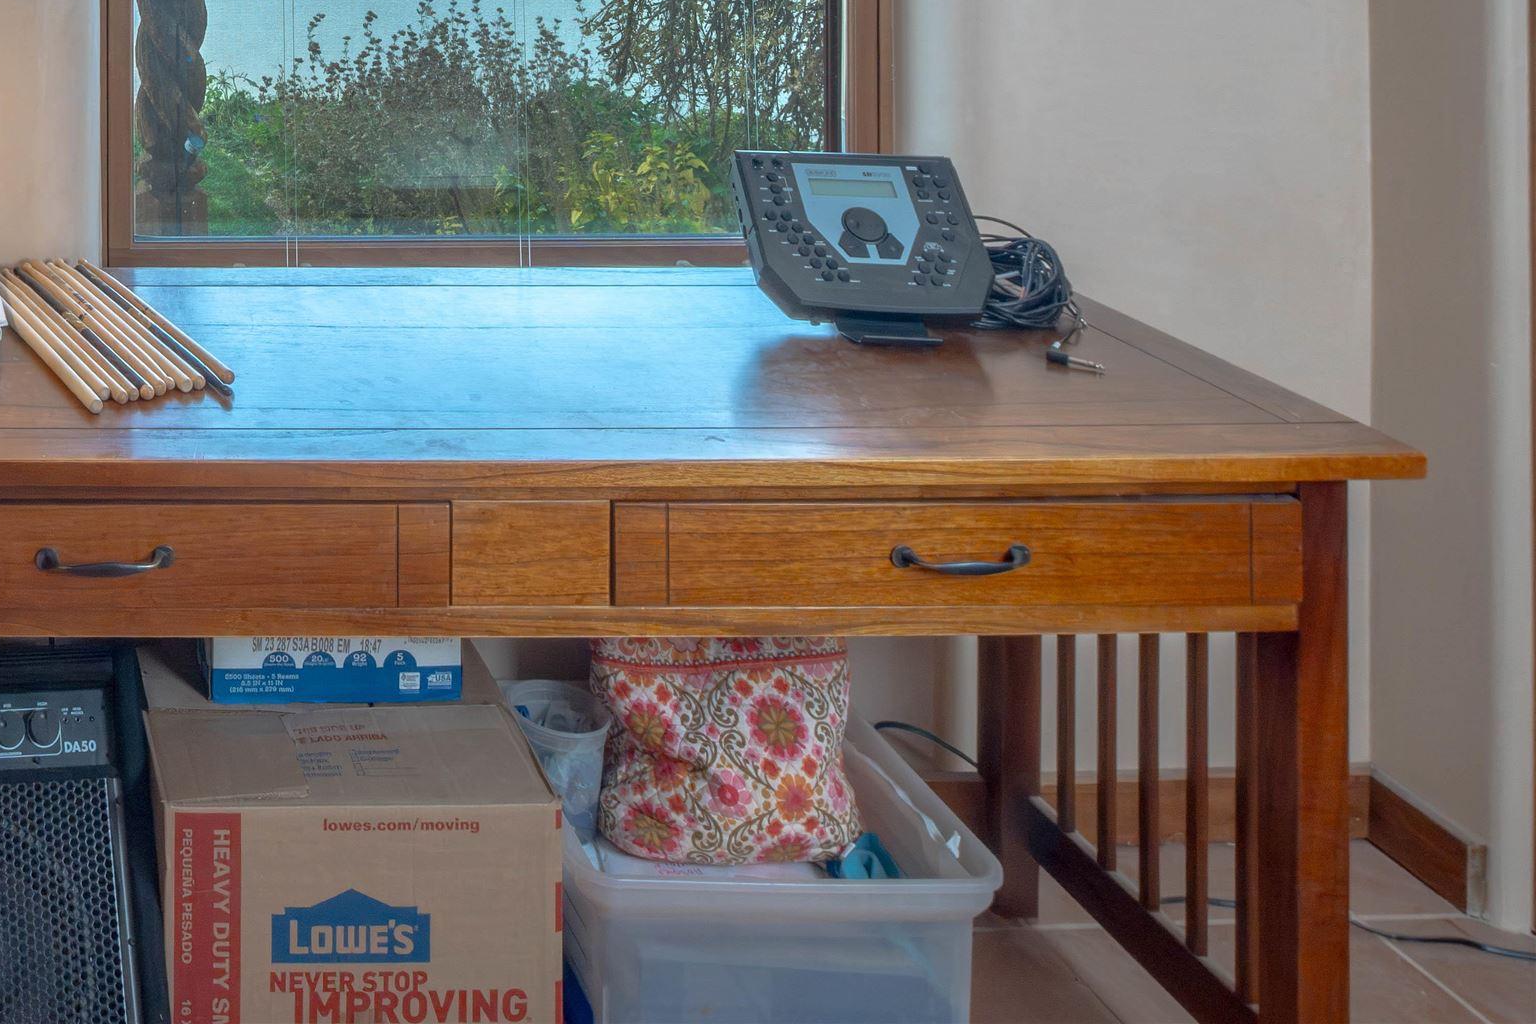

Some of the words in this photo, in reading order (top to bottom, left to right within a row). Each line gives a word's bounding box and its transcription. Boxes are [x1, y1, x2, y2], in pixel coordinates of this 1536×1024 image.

[264, 637, 275, 651] 23
[276, 637, 292, 652] 287
[337, 638, 351, 655] EM
[359, 639, 382, 654] 18:47
[353, 653, 367, 662] 92
[396, 652, 404, 662] 5
[269, 654, 289, 663] 500
[63, 739, 97, 753] DA50
[322, 818, 480, 834] lowes.com/moving
[180, 829, 195, 898] PEQUEÑA
[211, 829, 231, 915] HEAVY
[180, 902, 193, 965] PESADO
[289, 919, 416, 956] LOWE'S
[211, 922, 231, 990] DUTY
[269, 971, 354, 993] NEVER
[362, 970, 428, 993] STOP
[294, 988, 528, 1024] IMPROVING
